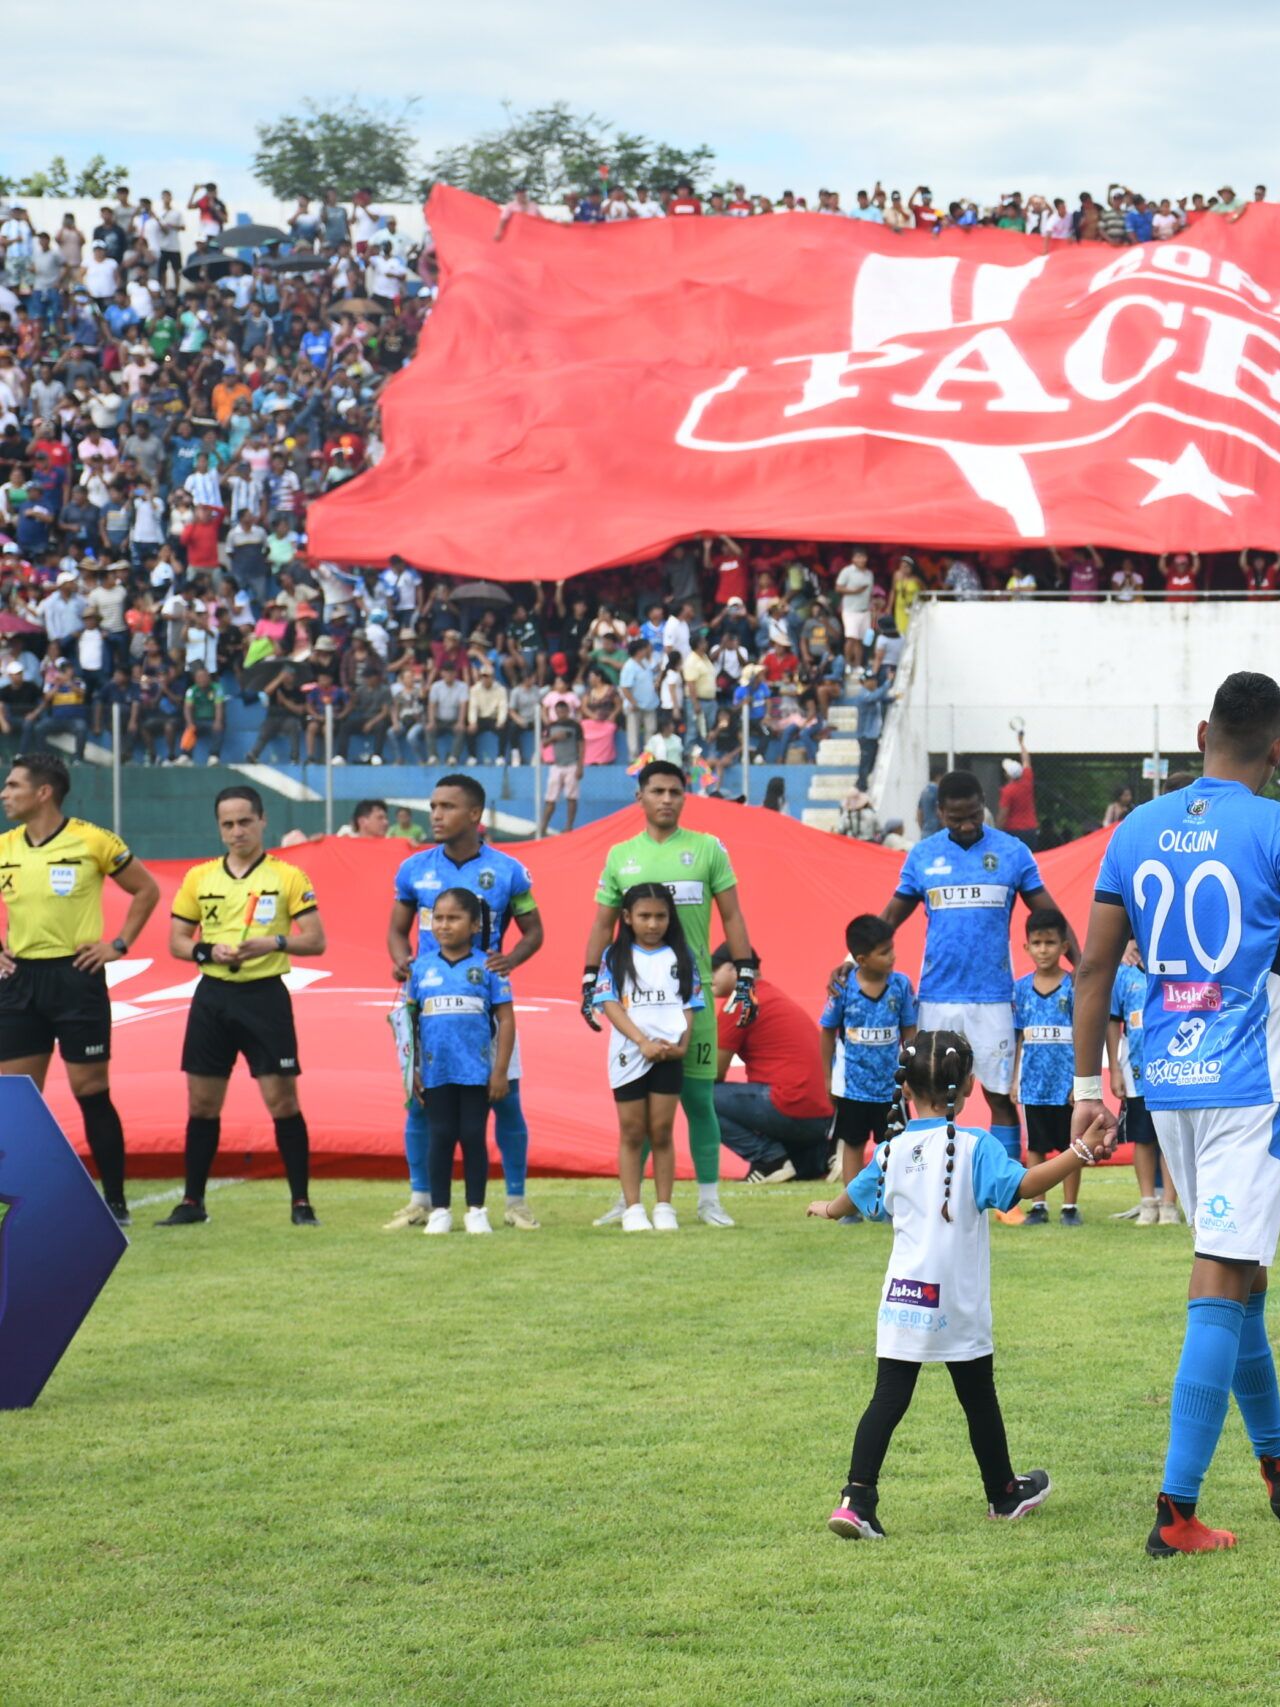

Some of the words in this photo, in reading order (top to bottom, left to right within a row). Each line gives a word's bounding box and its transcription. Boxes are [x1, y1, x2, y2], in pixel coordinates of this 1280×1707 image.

[1158, 829, 1219, 853] OLGUIN
[943, 887, 981, 900] UTB
[1132, 859, 1243, 975] 20
[434, 997, 464, 1008] UTB
[632, 990, 666, 1003] UTB
[861, 1029, 892, 1040] UTB
[1031, 1027, 1061, 1038] UTB
[696, 1042, 712, 1065] 12
